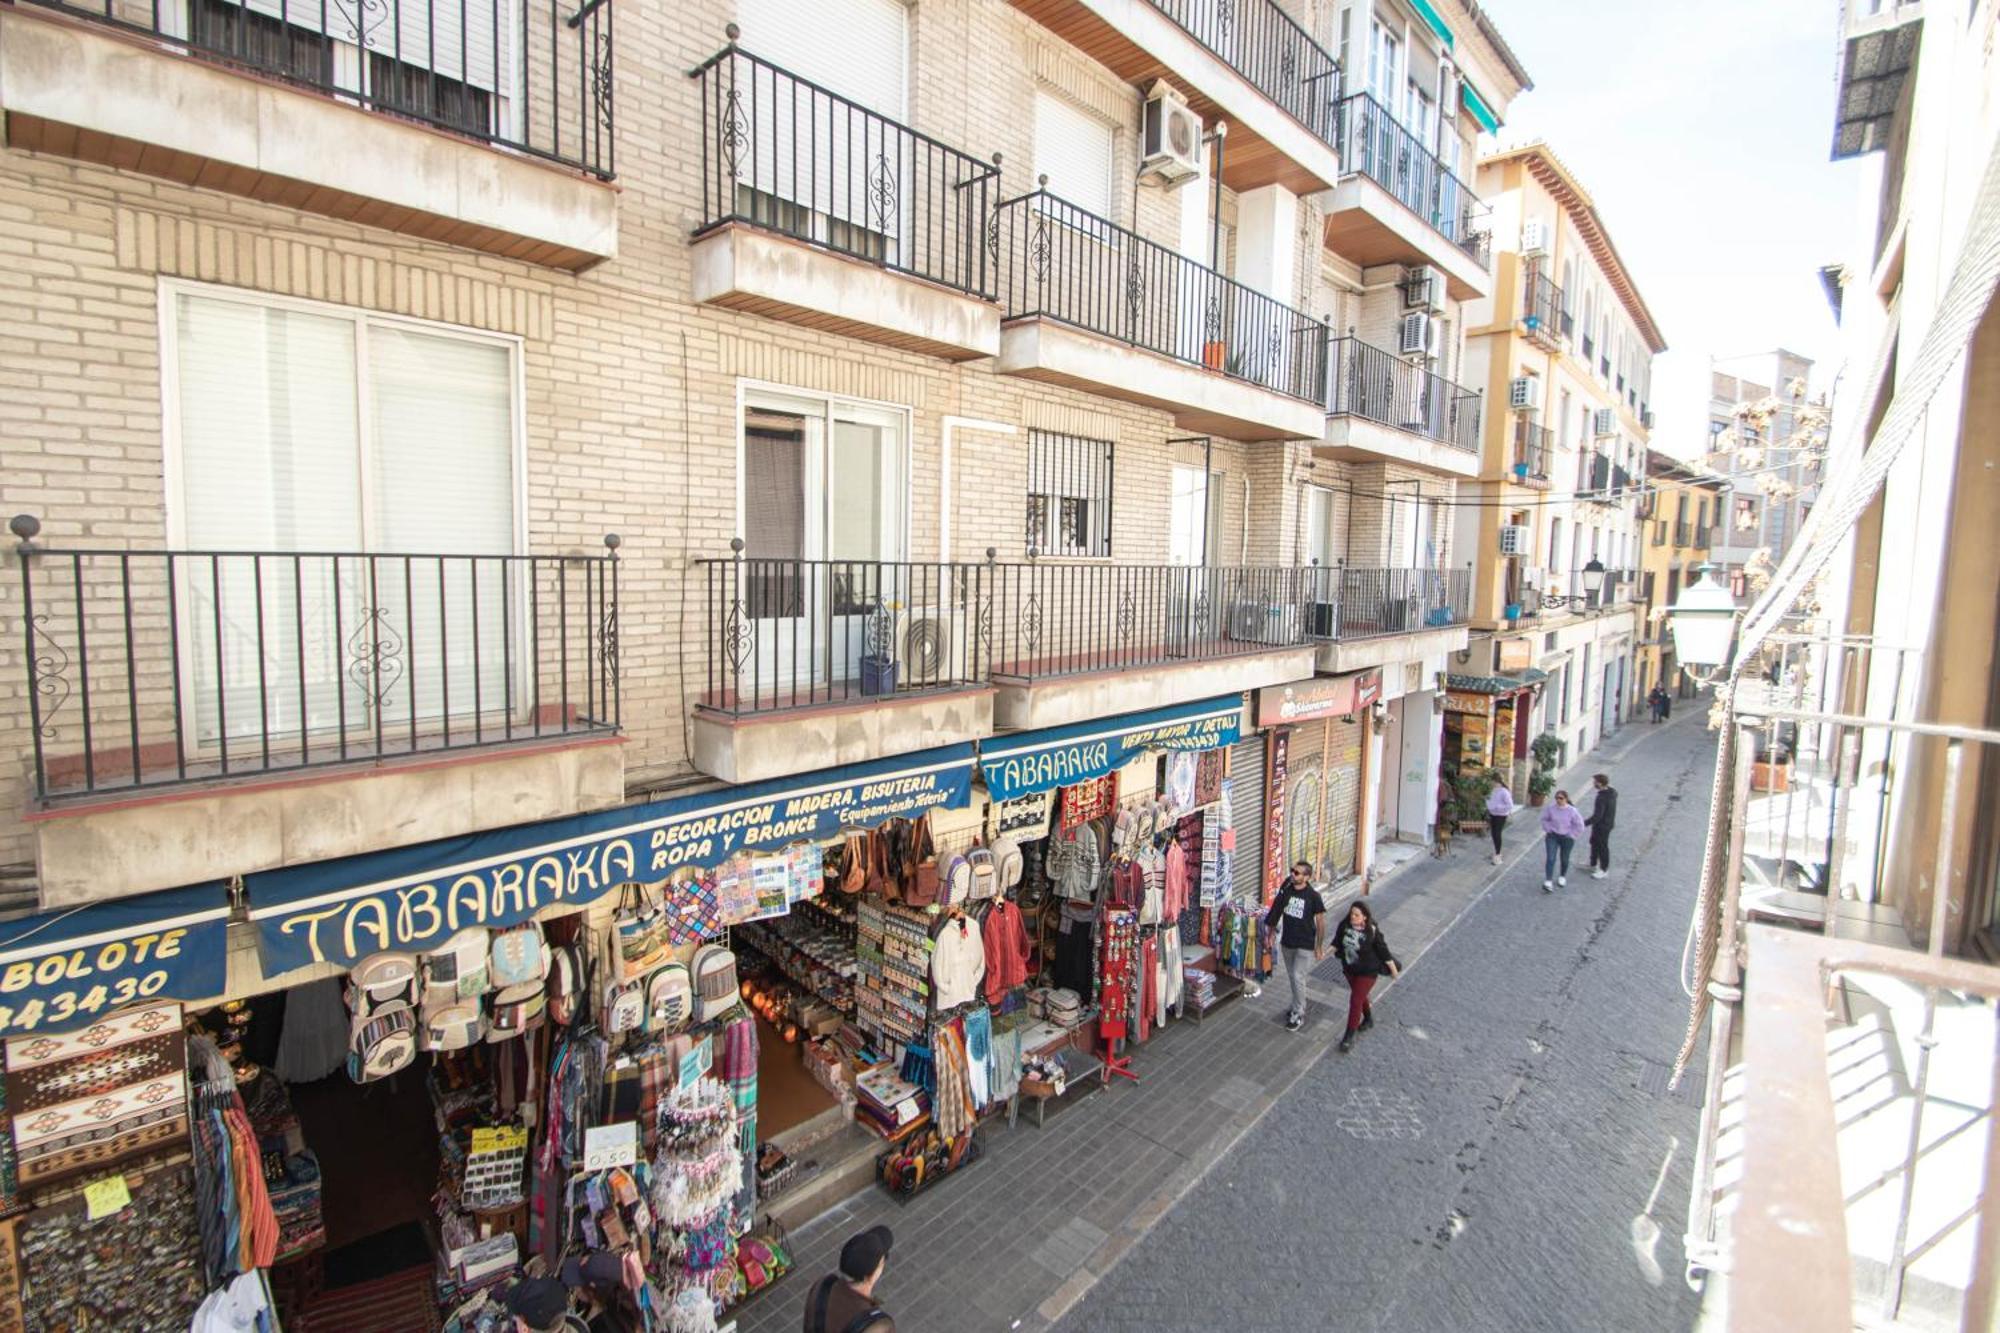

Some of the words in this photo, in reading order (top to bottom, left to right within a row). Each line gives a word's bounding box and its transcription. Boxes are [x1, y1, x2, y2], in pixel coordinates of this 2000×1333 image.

[1122, 731, 1154, 748] VENTA
[1156, 724, 1191, 740] MAYOR
[1194, 721, 1201, 734] Y
[984, 741, 1108, 791] TABARAKA
[650, 804, 774, 849] DECORACION
[785, 788, 857, 817] MADERA,
[861, 774, 936, 802] BISUTERIA
[651, 839, 713, 871] ROPA
[722, 831, 734, 851] Y
[744, 812, 818, 846] BRONCE
[280, 839, 636, 963] TABARAKA
